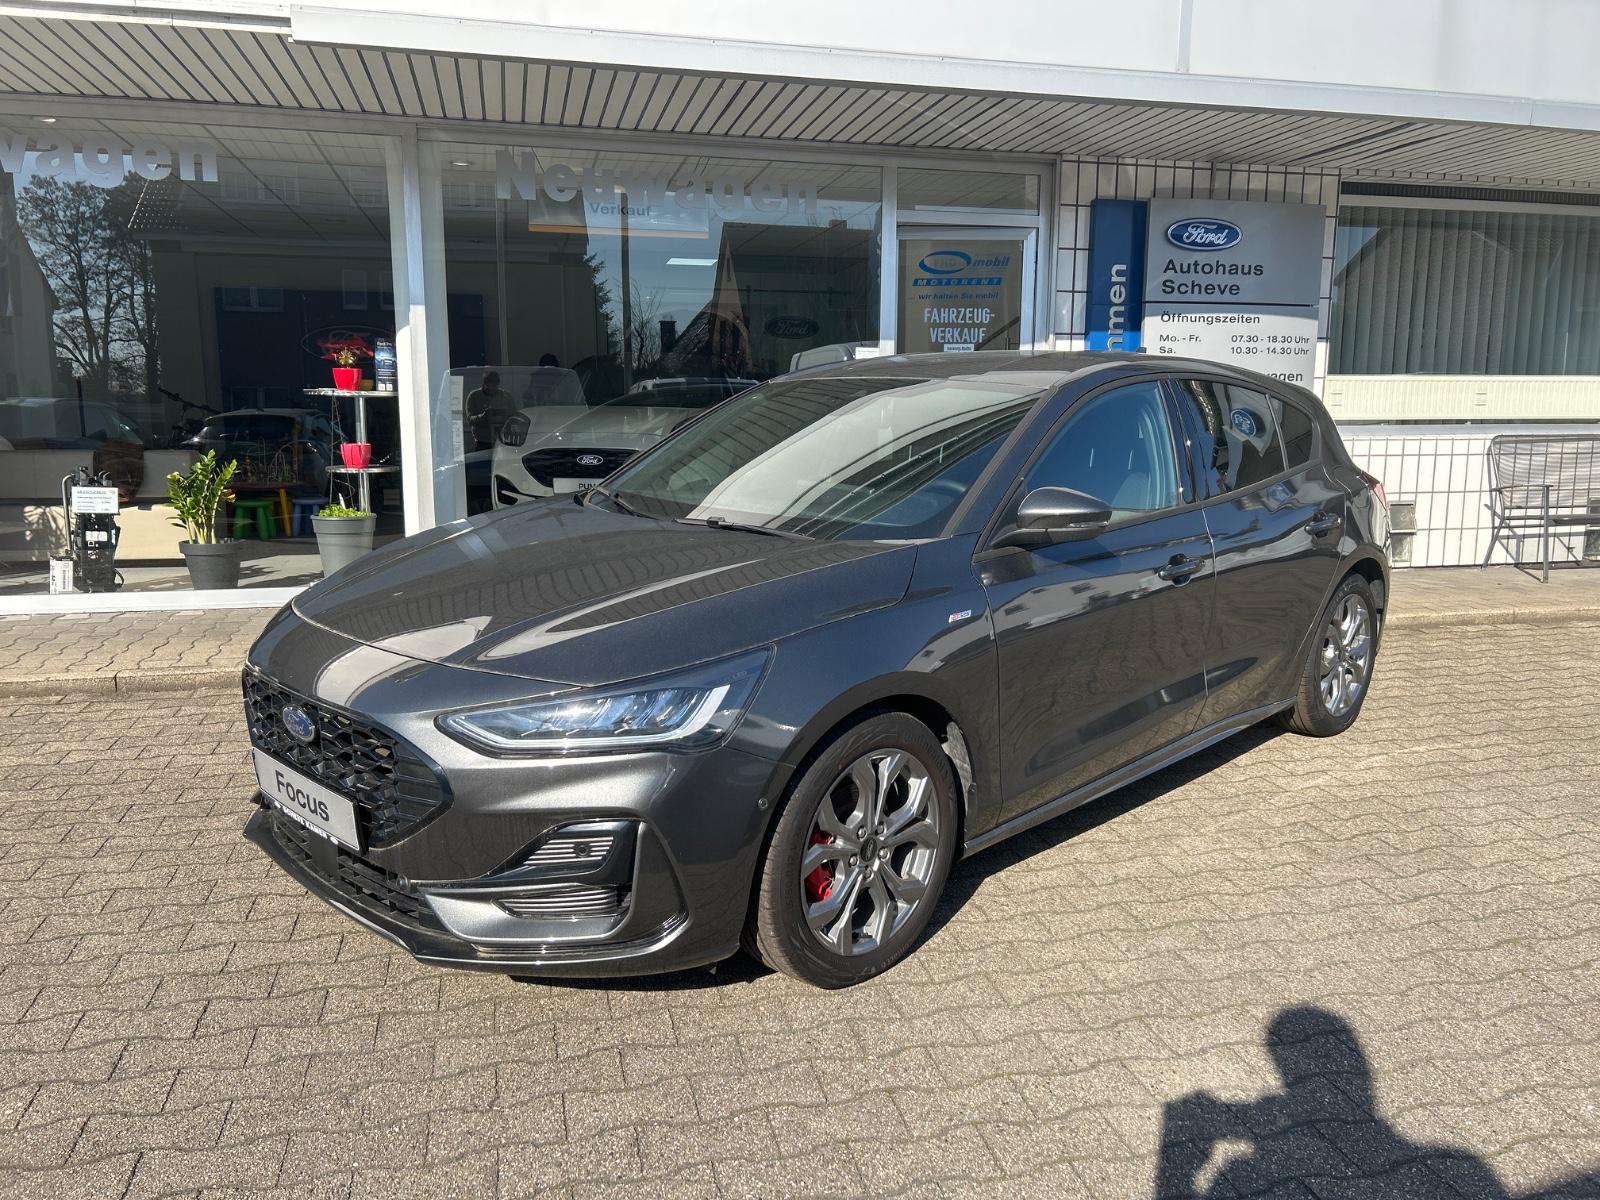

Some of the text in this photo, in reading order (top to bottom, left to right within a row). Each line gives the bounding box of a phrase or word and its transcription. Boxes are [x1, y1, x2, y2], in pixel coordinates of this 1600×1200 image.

[496, 149, 817, 220] Neuwagen
[589, 202, 651, 216] Verkauf
[973, 256, 1010, 268] mobil
[1163, 259, 1264, 276] Autohaus
[1162, 279, 1241, 296] Scheve
[924, 308, 995, 324] FAHRZEUG-
[1160, 311, 1261, 325] Öffnungszeiten
[929, 327, 986, 343] VERKAUF
[1159, 334, 1180, 343] Mo.
[1188, 335, 1202, 343] Fr.
[1231, 335, 1259, 344] 07.30
[1266, 335, 1293, 344] 18.30
[1294, 335, 1310, 344] Uhr
[1159, 346, 1176, 355] Sa.
[1230, 347, 1258, 355] 10.30
[1265, 347, 1292, 355] 14.30
[1294, 347, 1310, 355] Uhr
